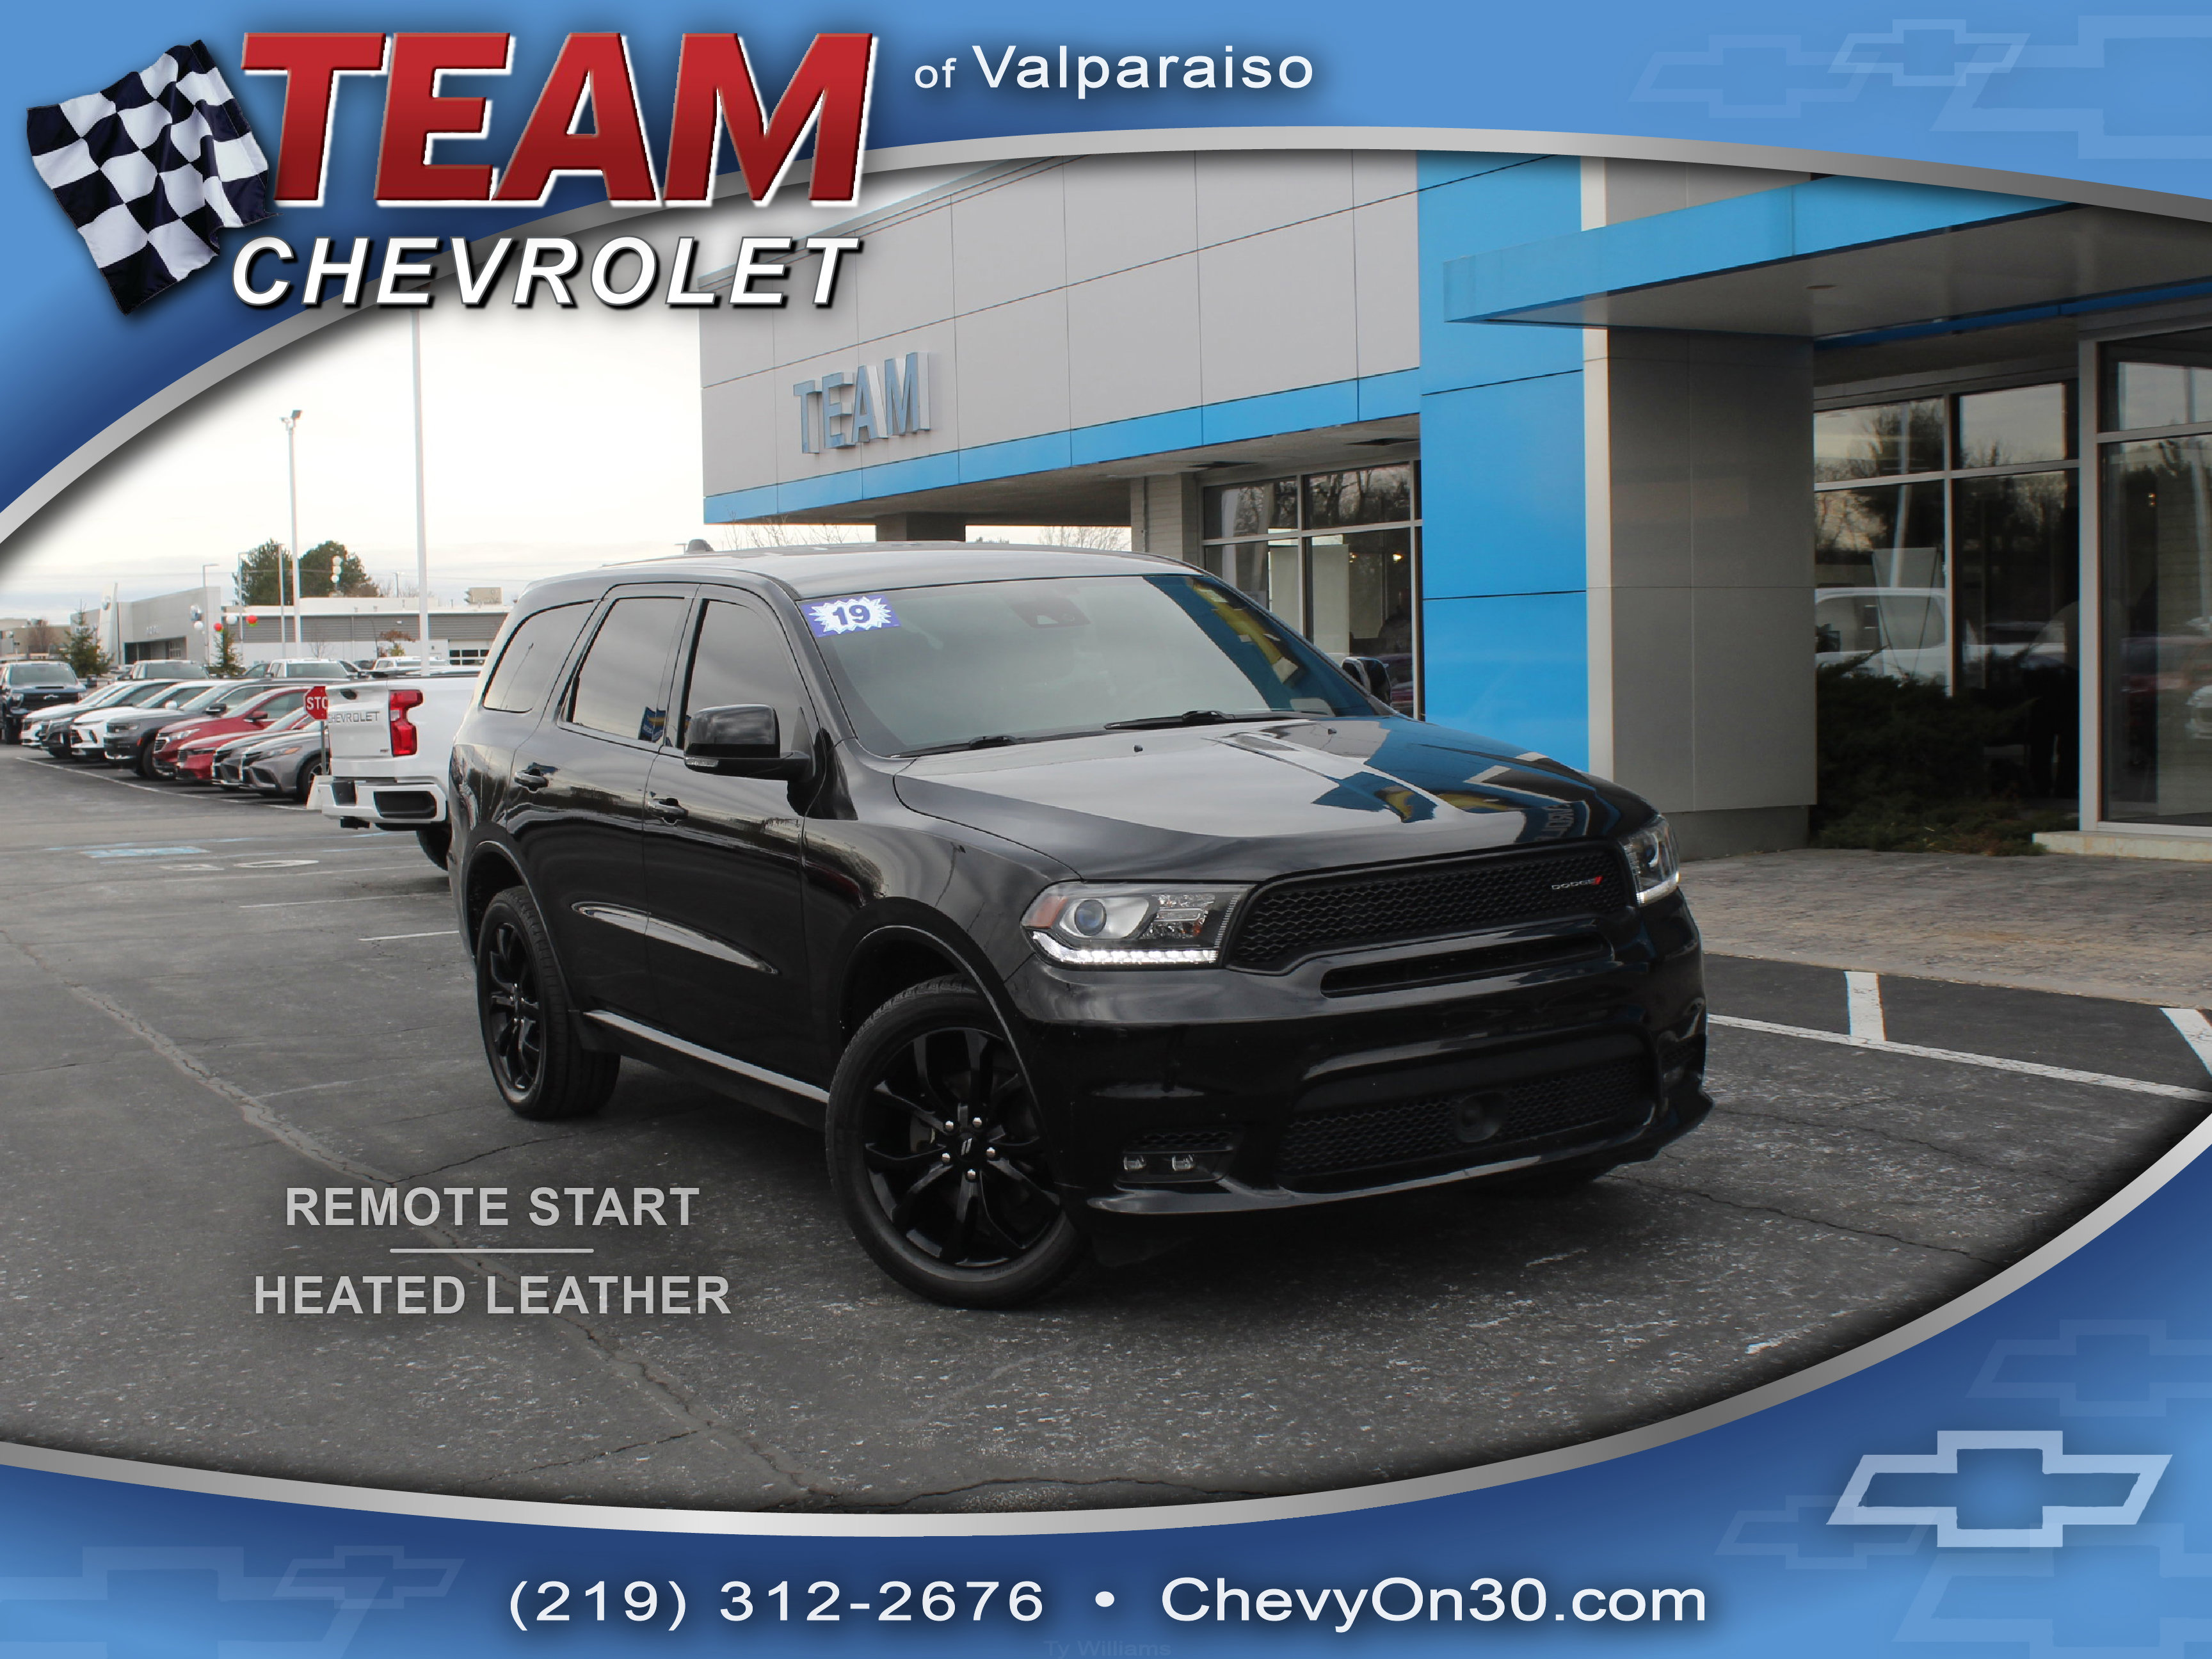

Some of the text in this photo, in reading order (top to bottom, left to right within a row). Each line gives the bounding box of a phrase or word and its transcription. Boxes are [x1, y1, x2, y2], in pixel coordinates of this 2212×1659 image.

[793, 352, 930, 454] TEAM
[833, 604, 871, 625] 19
[307, 696, 328, 710] STO
